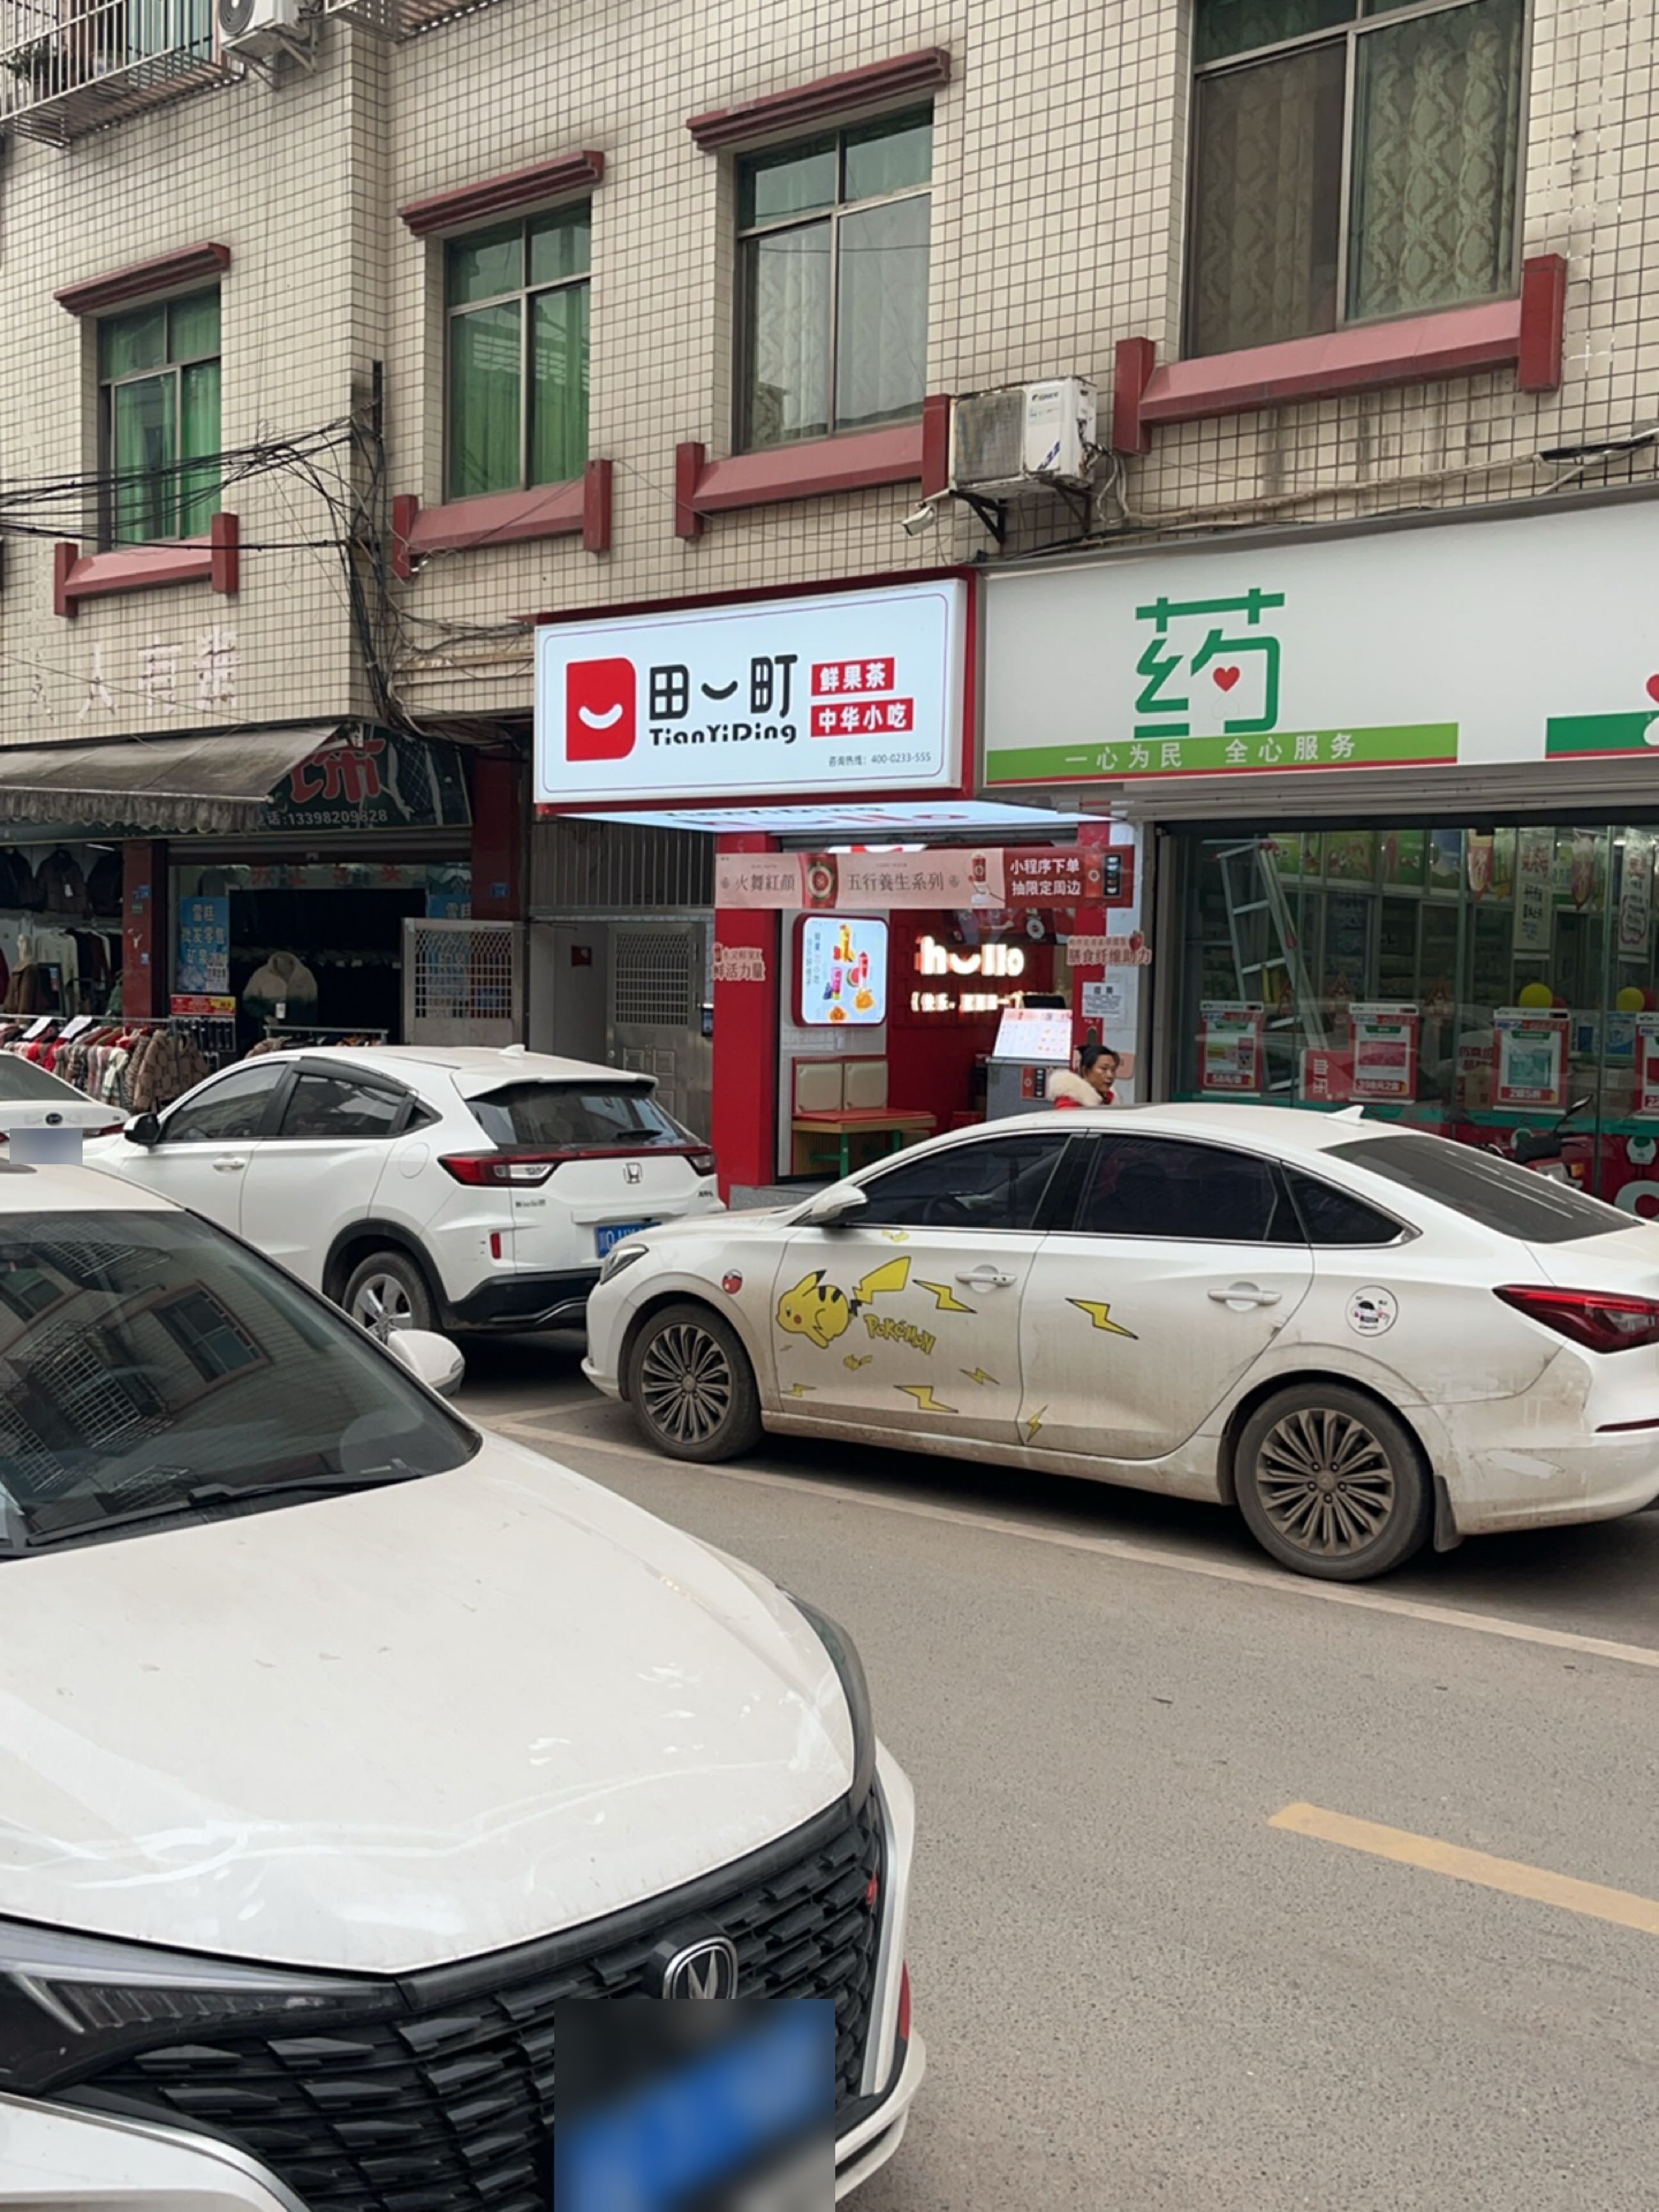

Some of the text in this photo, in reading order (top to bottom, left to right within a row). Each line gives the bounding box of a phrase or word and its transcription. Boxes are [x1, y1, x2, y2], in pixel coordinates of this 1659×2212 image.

[1134, 587, 1285, 739] 药
[819, 662, 886, 692] 鲜果茶
[818, 704, 908, 733] 中华小吃
[649, 723, 797, 746] TianYiDing
[1065, 733, 1356, 770] 一心为民 全心服务
[1010, 858, 1080, 875] 小程序下单
[847, 872, 944, 892] 五行養生系列
[1013, 880, 1081, 896] 抽限定周边
